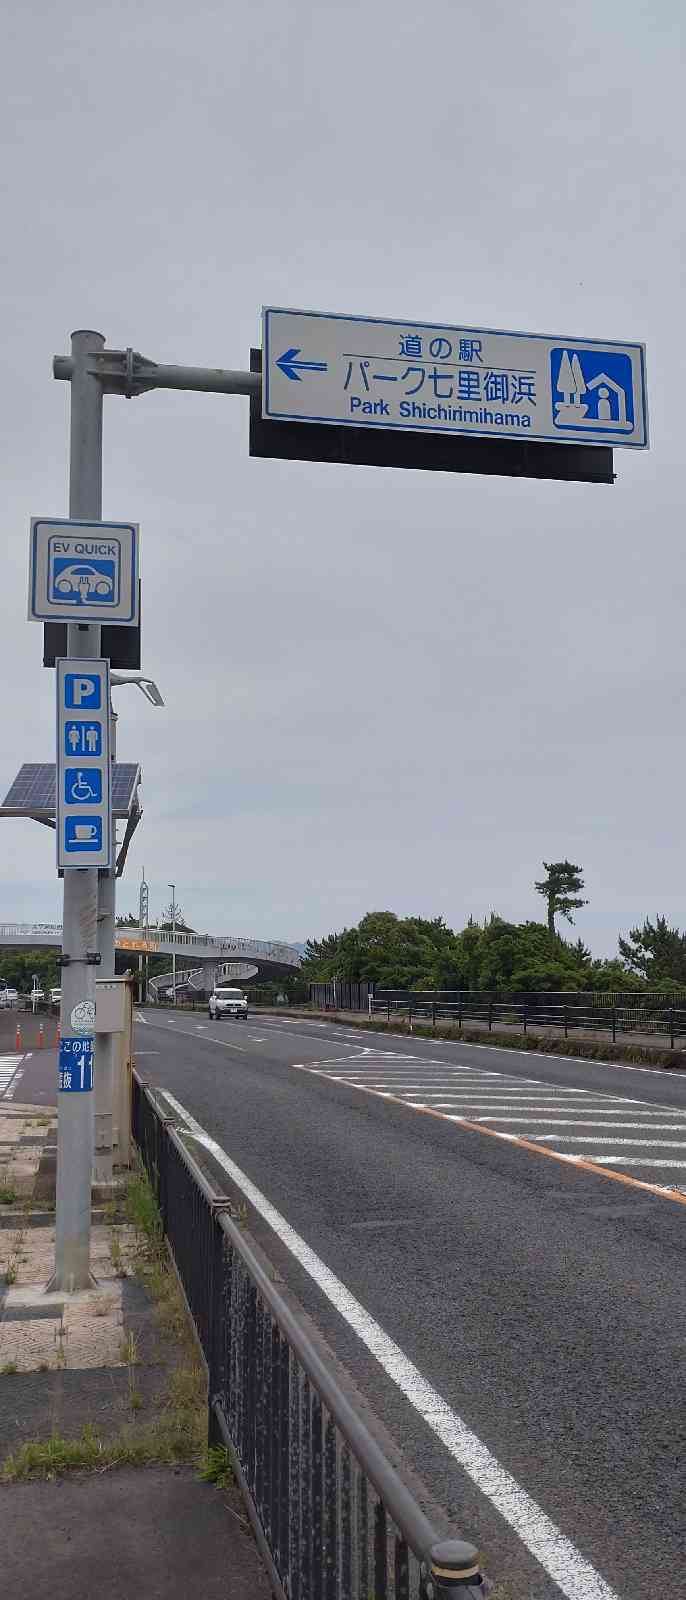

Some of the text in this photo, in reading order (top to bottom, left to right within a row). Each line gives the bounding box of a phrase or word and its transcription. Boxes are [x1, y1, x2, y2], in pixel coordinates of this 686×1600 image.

[398, 334, 484, 363] 道の駅
[343, 360, 537, 407] パーク七里御浜
[349, 396, 532, 429] Park Shichirimihama
[53, 542, 116, 556] EV QUICK
[73, 678, 96, 705] P
